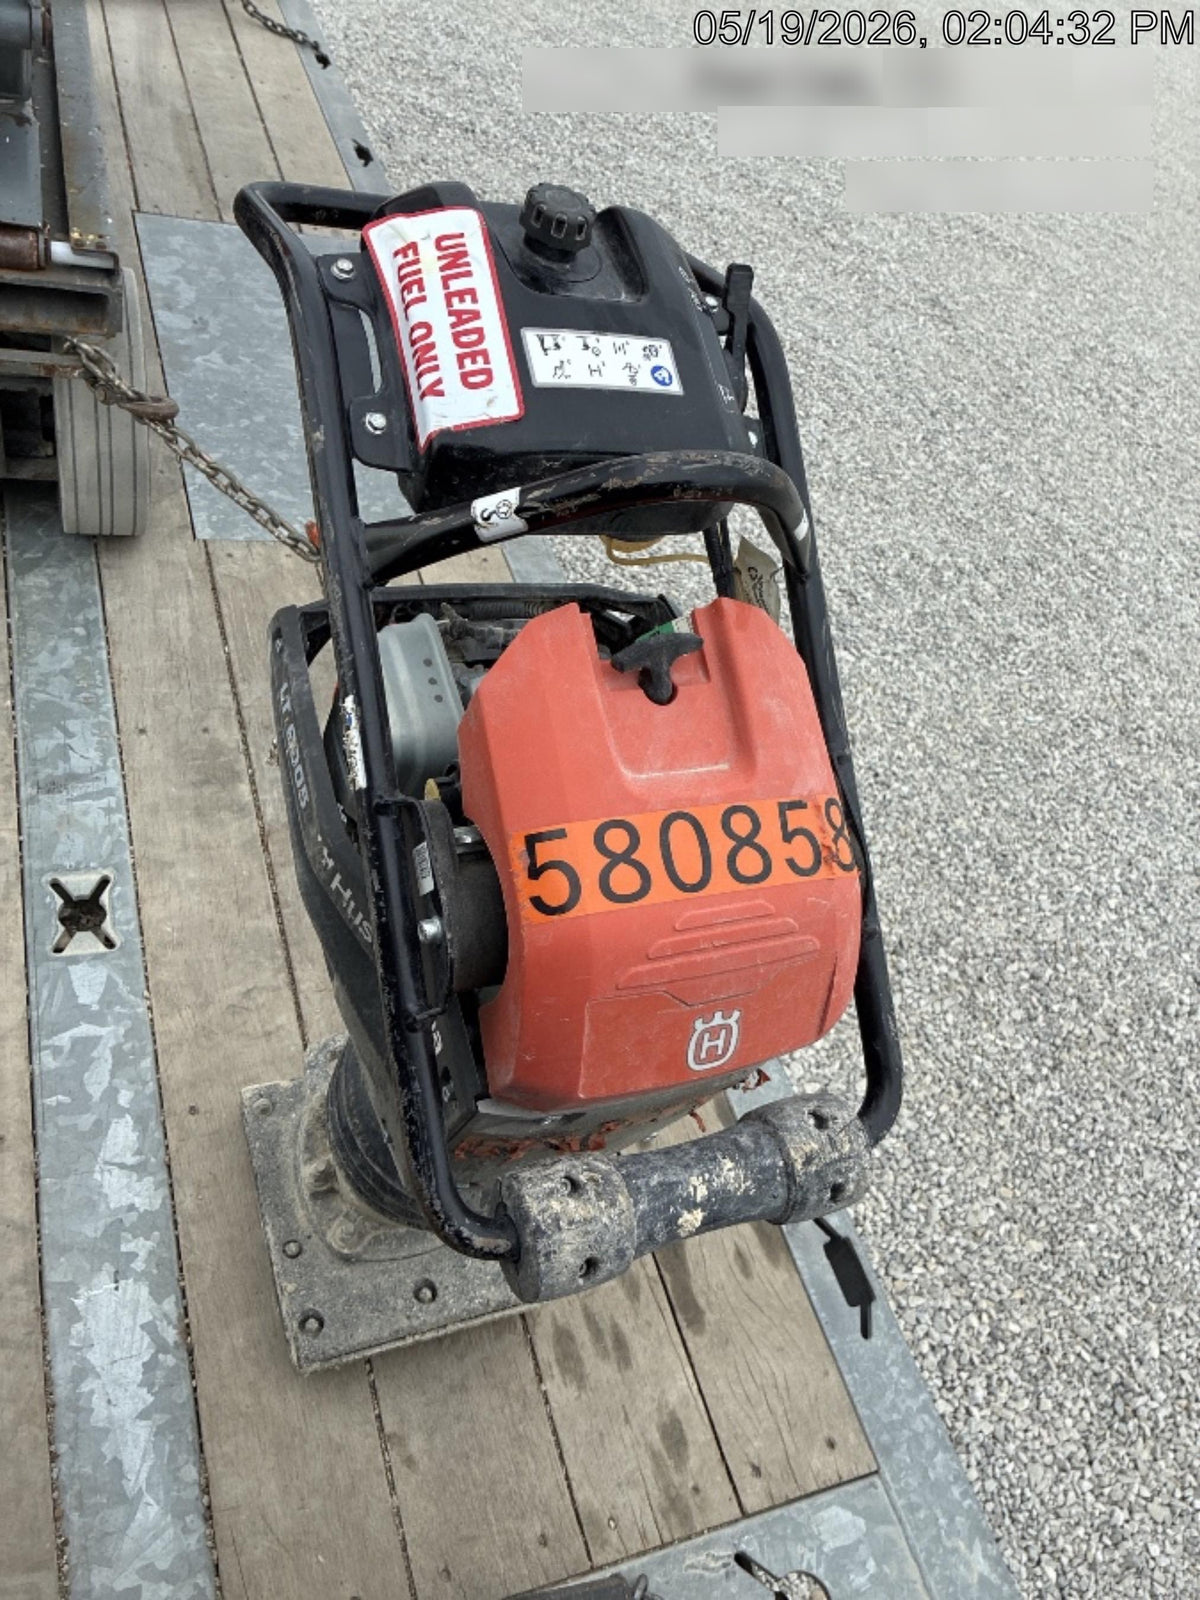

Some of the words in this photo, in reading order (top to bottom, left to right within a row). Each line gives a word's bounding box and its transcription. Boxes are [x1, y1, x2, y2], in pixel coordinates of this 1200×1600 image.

[393, 241, 428, 321] FUEL
[434, 232, 494, 391] UNLEADED
[407, 320, 446, 402] ONLY
[523, 796, 857, 917] 580858
